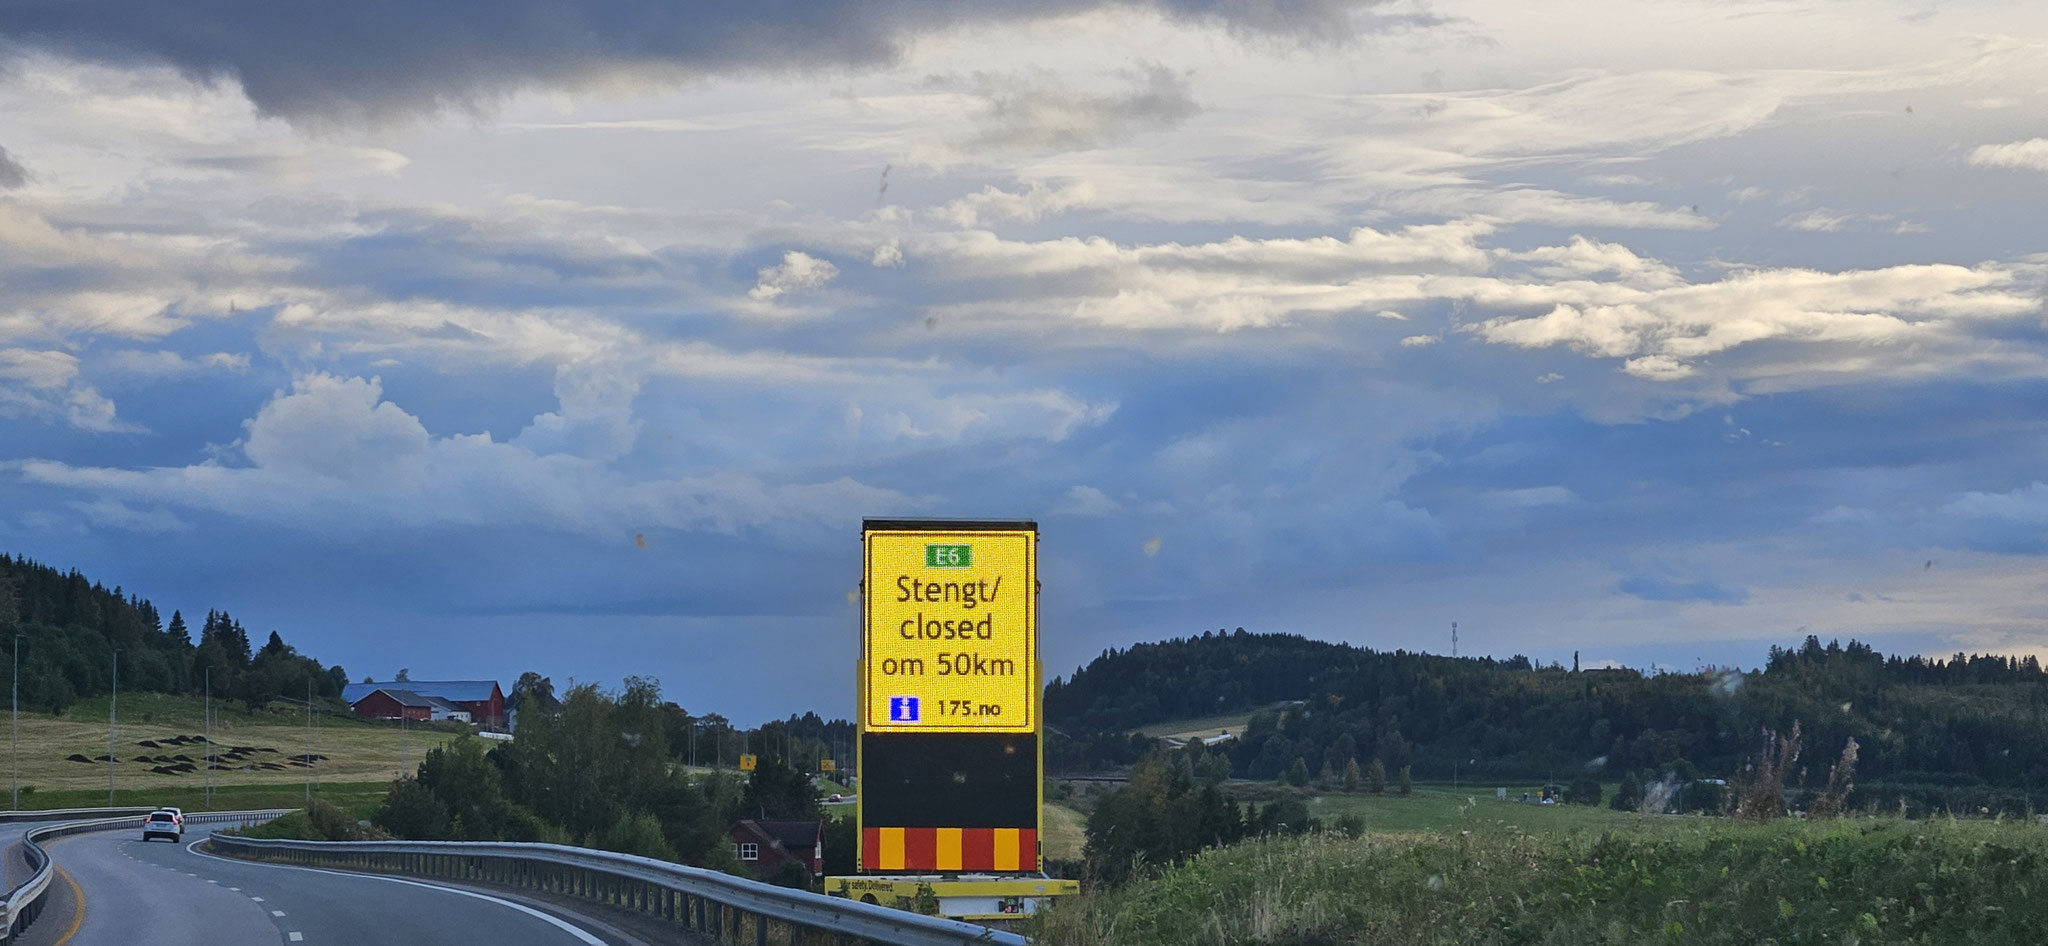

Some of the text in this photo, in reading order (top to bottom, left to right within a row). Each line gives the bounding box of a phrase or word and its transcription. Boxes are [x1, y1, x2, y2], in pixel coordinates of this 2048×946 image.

[936, 548, 960, 565] E6
[897, 575, 1001, 609] Stengt/
[900, 613, 992, 640] closed
[882, 653, 1014, 676] om 50km
[938, 700, 1001, 716] 175.no
